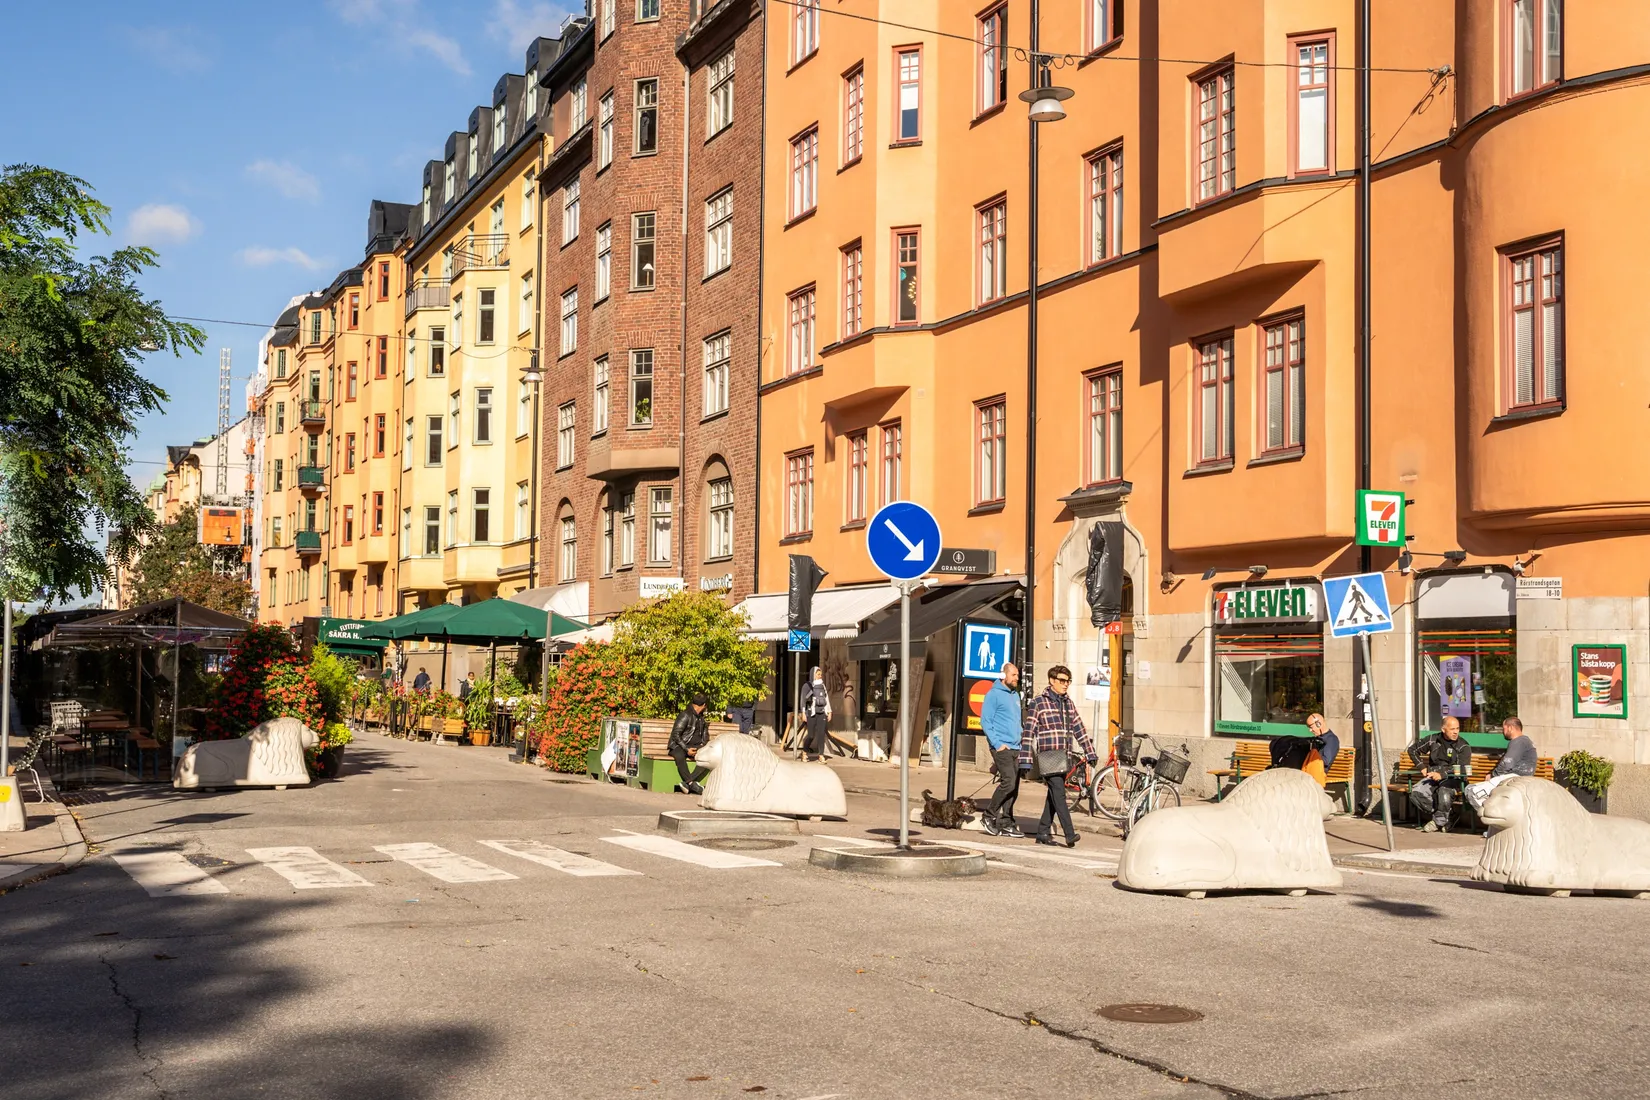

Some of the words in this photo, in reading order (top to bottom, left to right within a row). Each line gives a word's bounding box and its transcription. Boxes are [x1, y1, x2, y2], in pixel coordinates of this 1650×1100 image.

[643, 582, 678, 590] LUNDBERG
[1520, 579, 1560, 587] Rörstrandsgatan
[328, 630, 351, 639] SÄKRA
[1580, 652, 1599, 660] Stans
[1580, 660, 1598, 668] bästa
[1598, 660, 1616, 669] kopp
